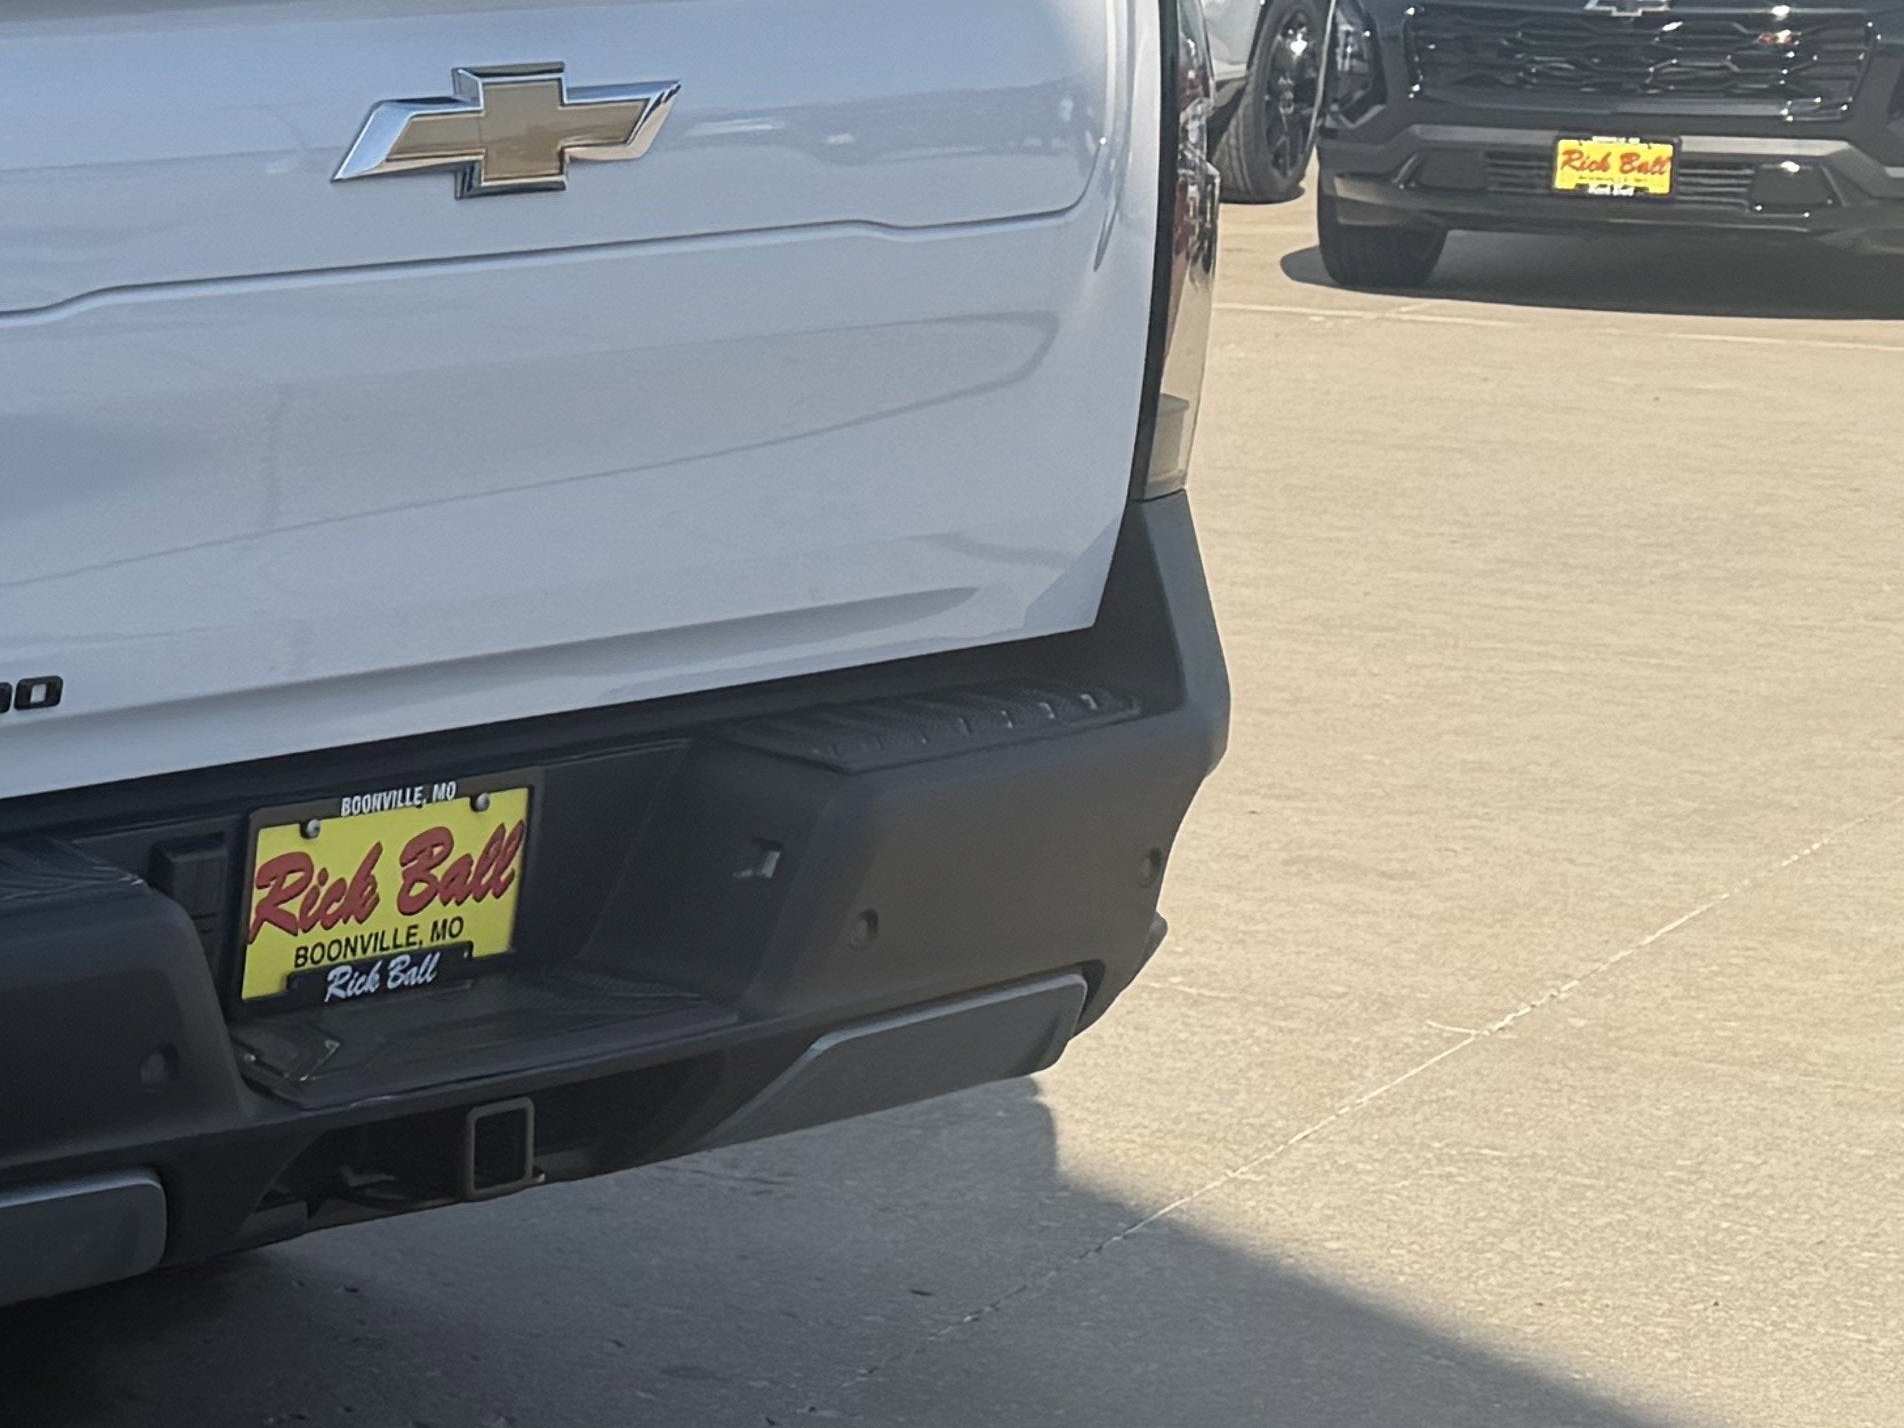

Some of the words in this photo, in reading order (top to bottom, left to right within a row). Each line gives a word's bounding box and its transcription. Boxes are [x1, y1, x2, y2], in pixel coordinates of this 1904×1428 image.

[1560, 148, 1612, 172] Rick
[1619, 151, 1672, 175] Ball
[340, 785, 427, 817] BOONVILLE,
[432, 780, 457, 802] MO
[247, 840, 384, 945] Rick
[396, 818, 525, 916] Ball
[294, 923, 423, 968] BOONVILLE,
[430, 916, 464, 943] MO
[323, 959, 382, 1003] Rick
[387, 952, 441, 990] Ball
